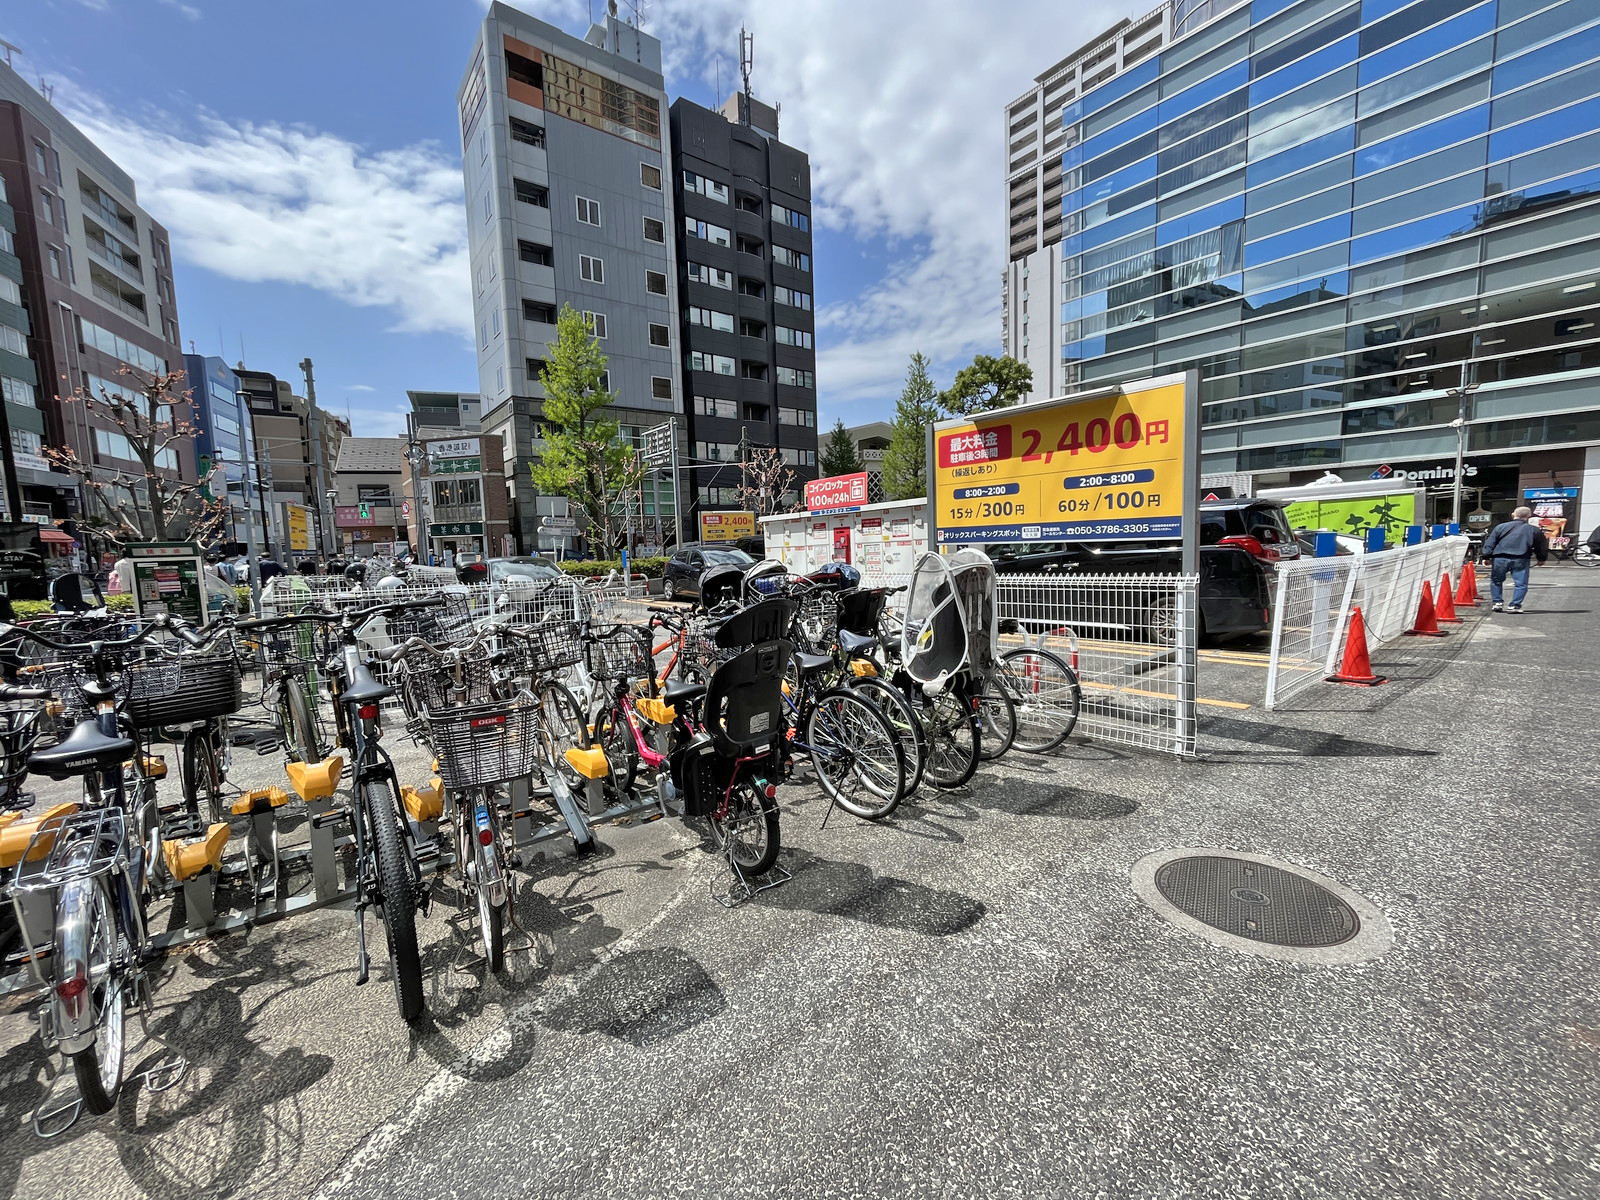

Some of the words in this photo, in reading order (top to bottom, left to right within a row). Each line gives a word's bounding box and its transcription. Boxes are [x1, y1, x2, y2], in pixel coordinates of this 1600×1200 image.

[950, 431, 998, 452] 最大料金
[1021, 412, 1169, 464] 2,400円
[950, 447, 998, 463] 駐車後3時間
[1393, 463, 1478, 480] Domino's
[808, 480, 850, 493] コインロッカー
[810, 492, 850, 507] 100円/24h
[944, 529, 1021, 539] オリックスパーキングスポット
[1074, 524, 1150, 535] 050-3786-3305
[478, 717, 498, 725] OGK
[64, 757, 98, 768] YAMAHA
